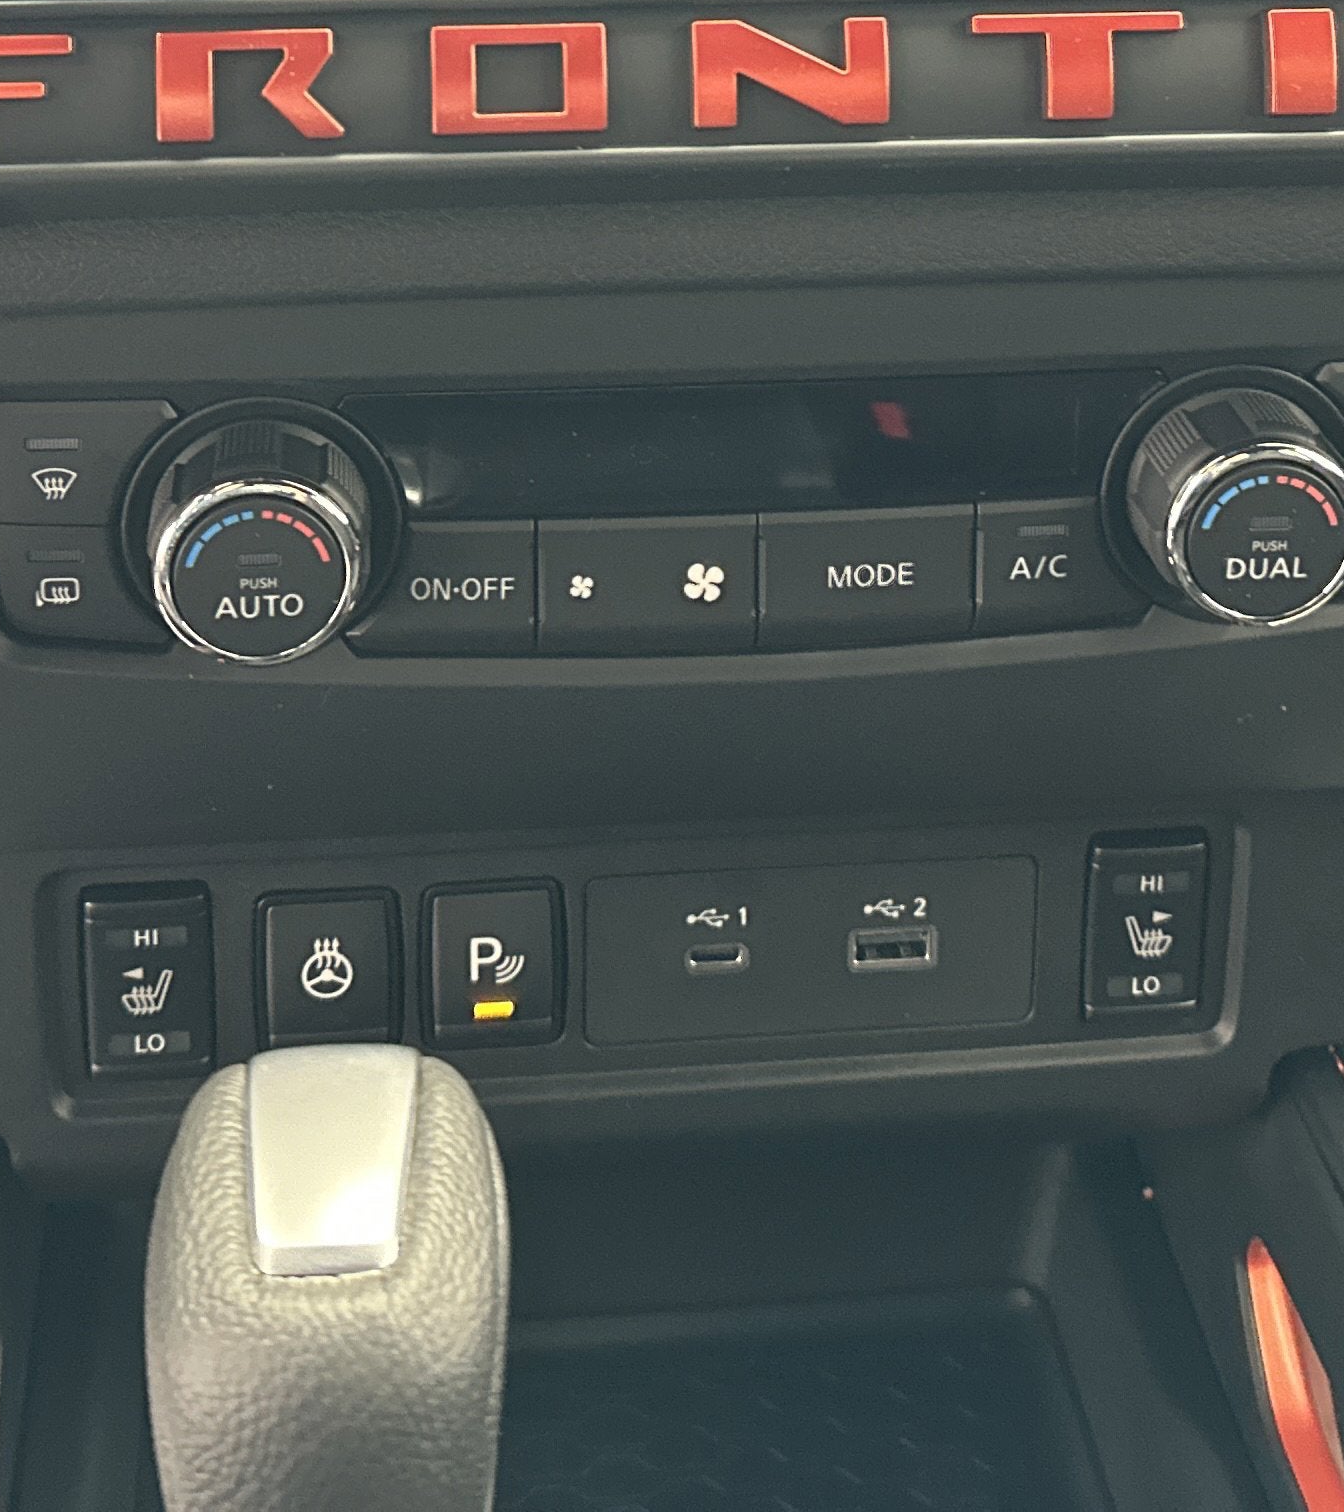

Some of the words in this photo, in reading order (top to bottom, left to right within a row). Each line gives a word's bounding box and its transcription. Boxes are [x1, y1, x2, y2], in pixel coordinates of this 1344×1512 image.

[1251, 539, 1288, 552] PUSH
[826, 562, 915, 589] MODE
[1009, 555, 1069, 580] A/C
[1224, 555, 1308, 581] DUAL
[239, 577, 278, 589] PUSH
[214, 594, 304, 619] AUTO
[1140, 875, 1164, 893] HI
[737, 906, 749, 927] 1
[913, 898, 928, 917] 2
[133, 929, 159, 947] HI
[468, 936, 503, 985] P
[1131, 976, 1161, 995] LO
[134, 1034, 165, 1053] LO
